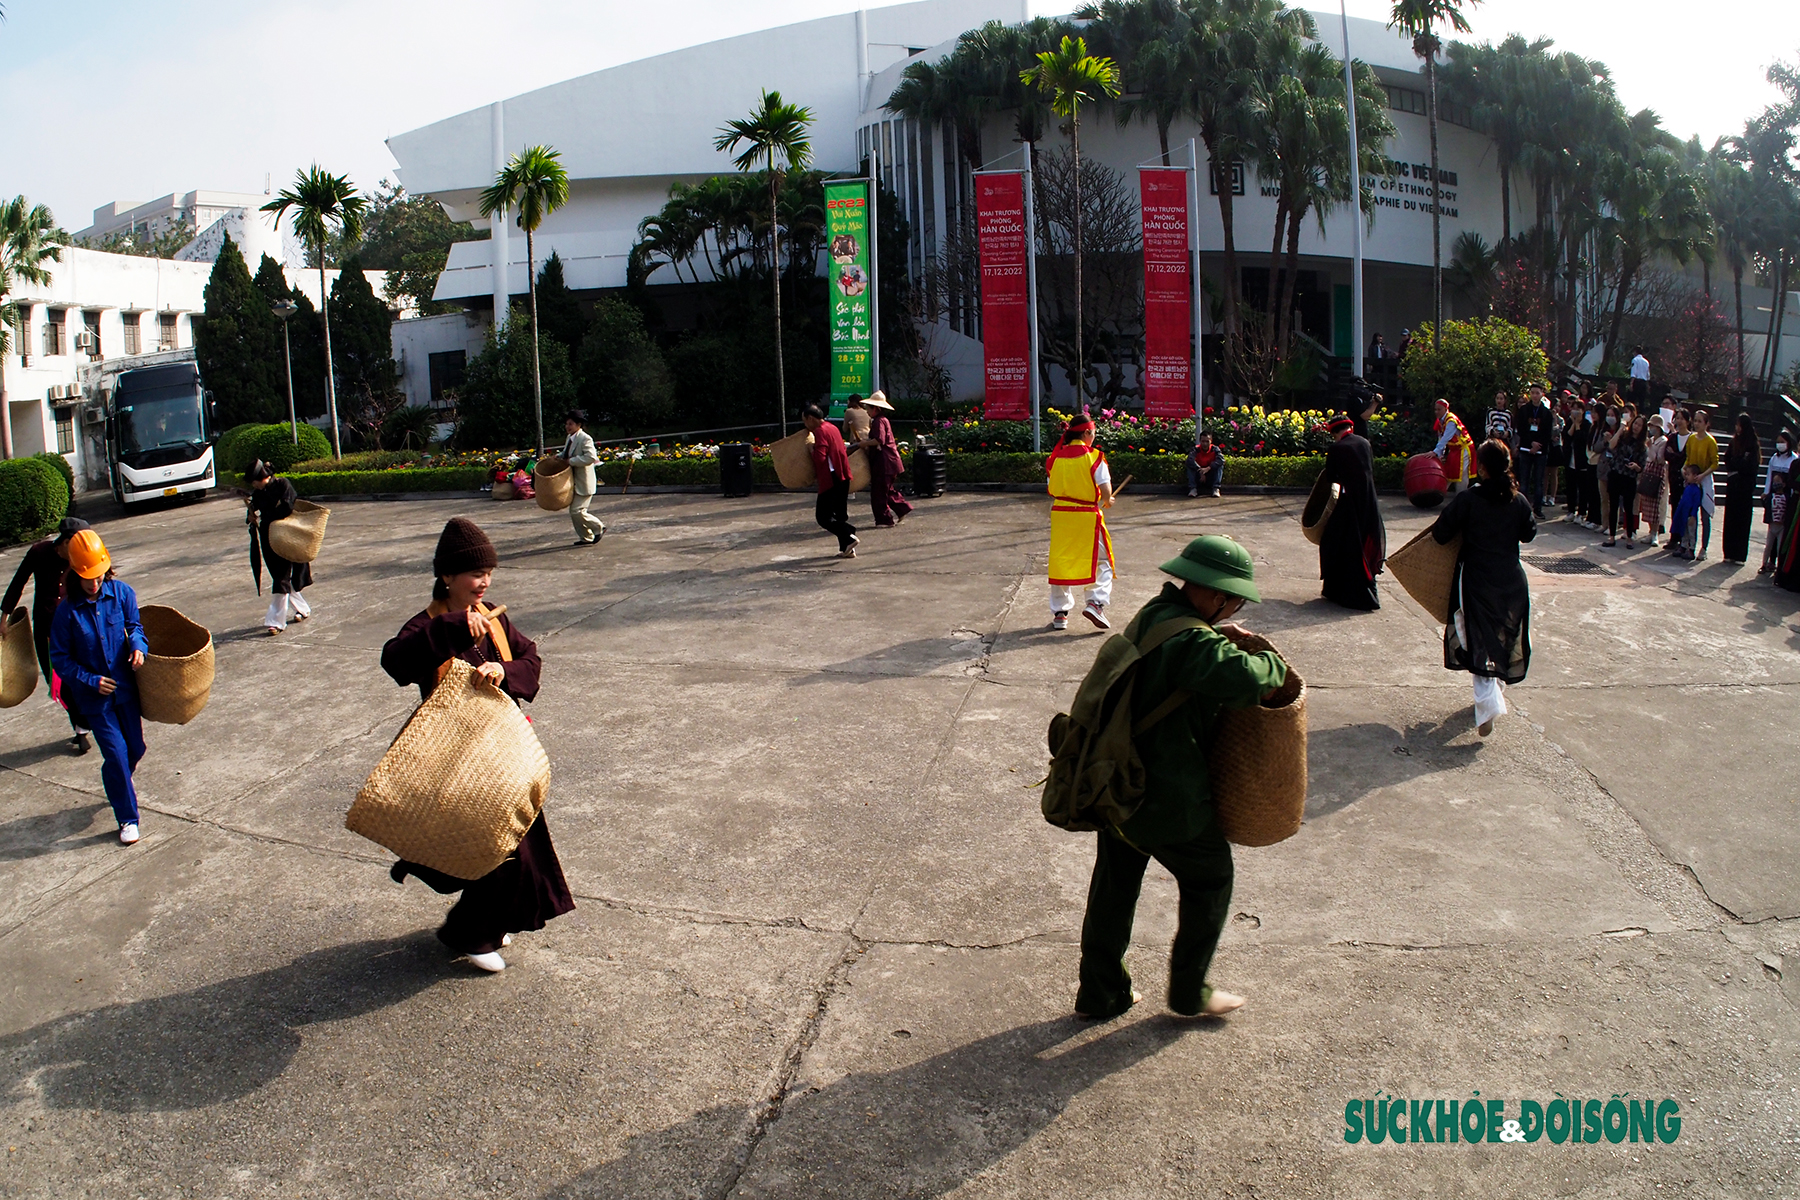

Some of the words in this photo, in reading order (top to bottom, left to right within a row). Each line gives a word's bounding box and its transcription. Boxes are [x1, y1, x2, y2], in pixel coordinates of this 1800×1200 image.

[1398, 182, 1457, 202] ETHNOOGY
[1404, 200, 1416, 210] DU
[1418, 202, 1458, 218] VIENAM
[980, 224, 998, 234] HÀN
[999, 222, 1022, 234] QUỐC
[1144, 220, 1160, 229] HÀN
[1162, 220, 1186, 230] QUỐC
[984, 268, 1022, 276] 17.12.2022
[1147, 264, 1186, 273] 17.12.2022
[838, 354, 848, 362] 28
[855, 354, 866, 362] 29
[842, 376, 862, 384] 2023
